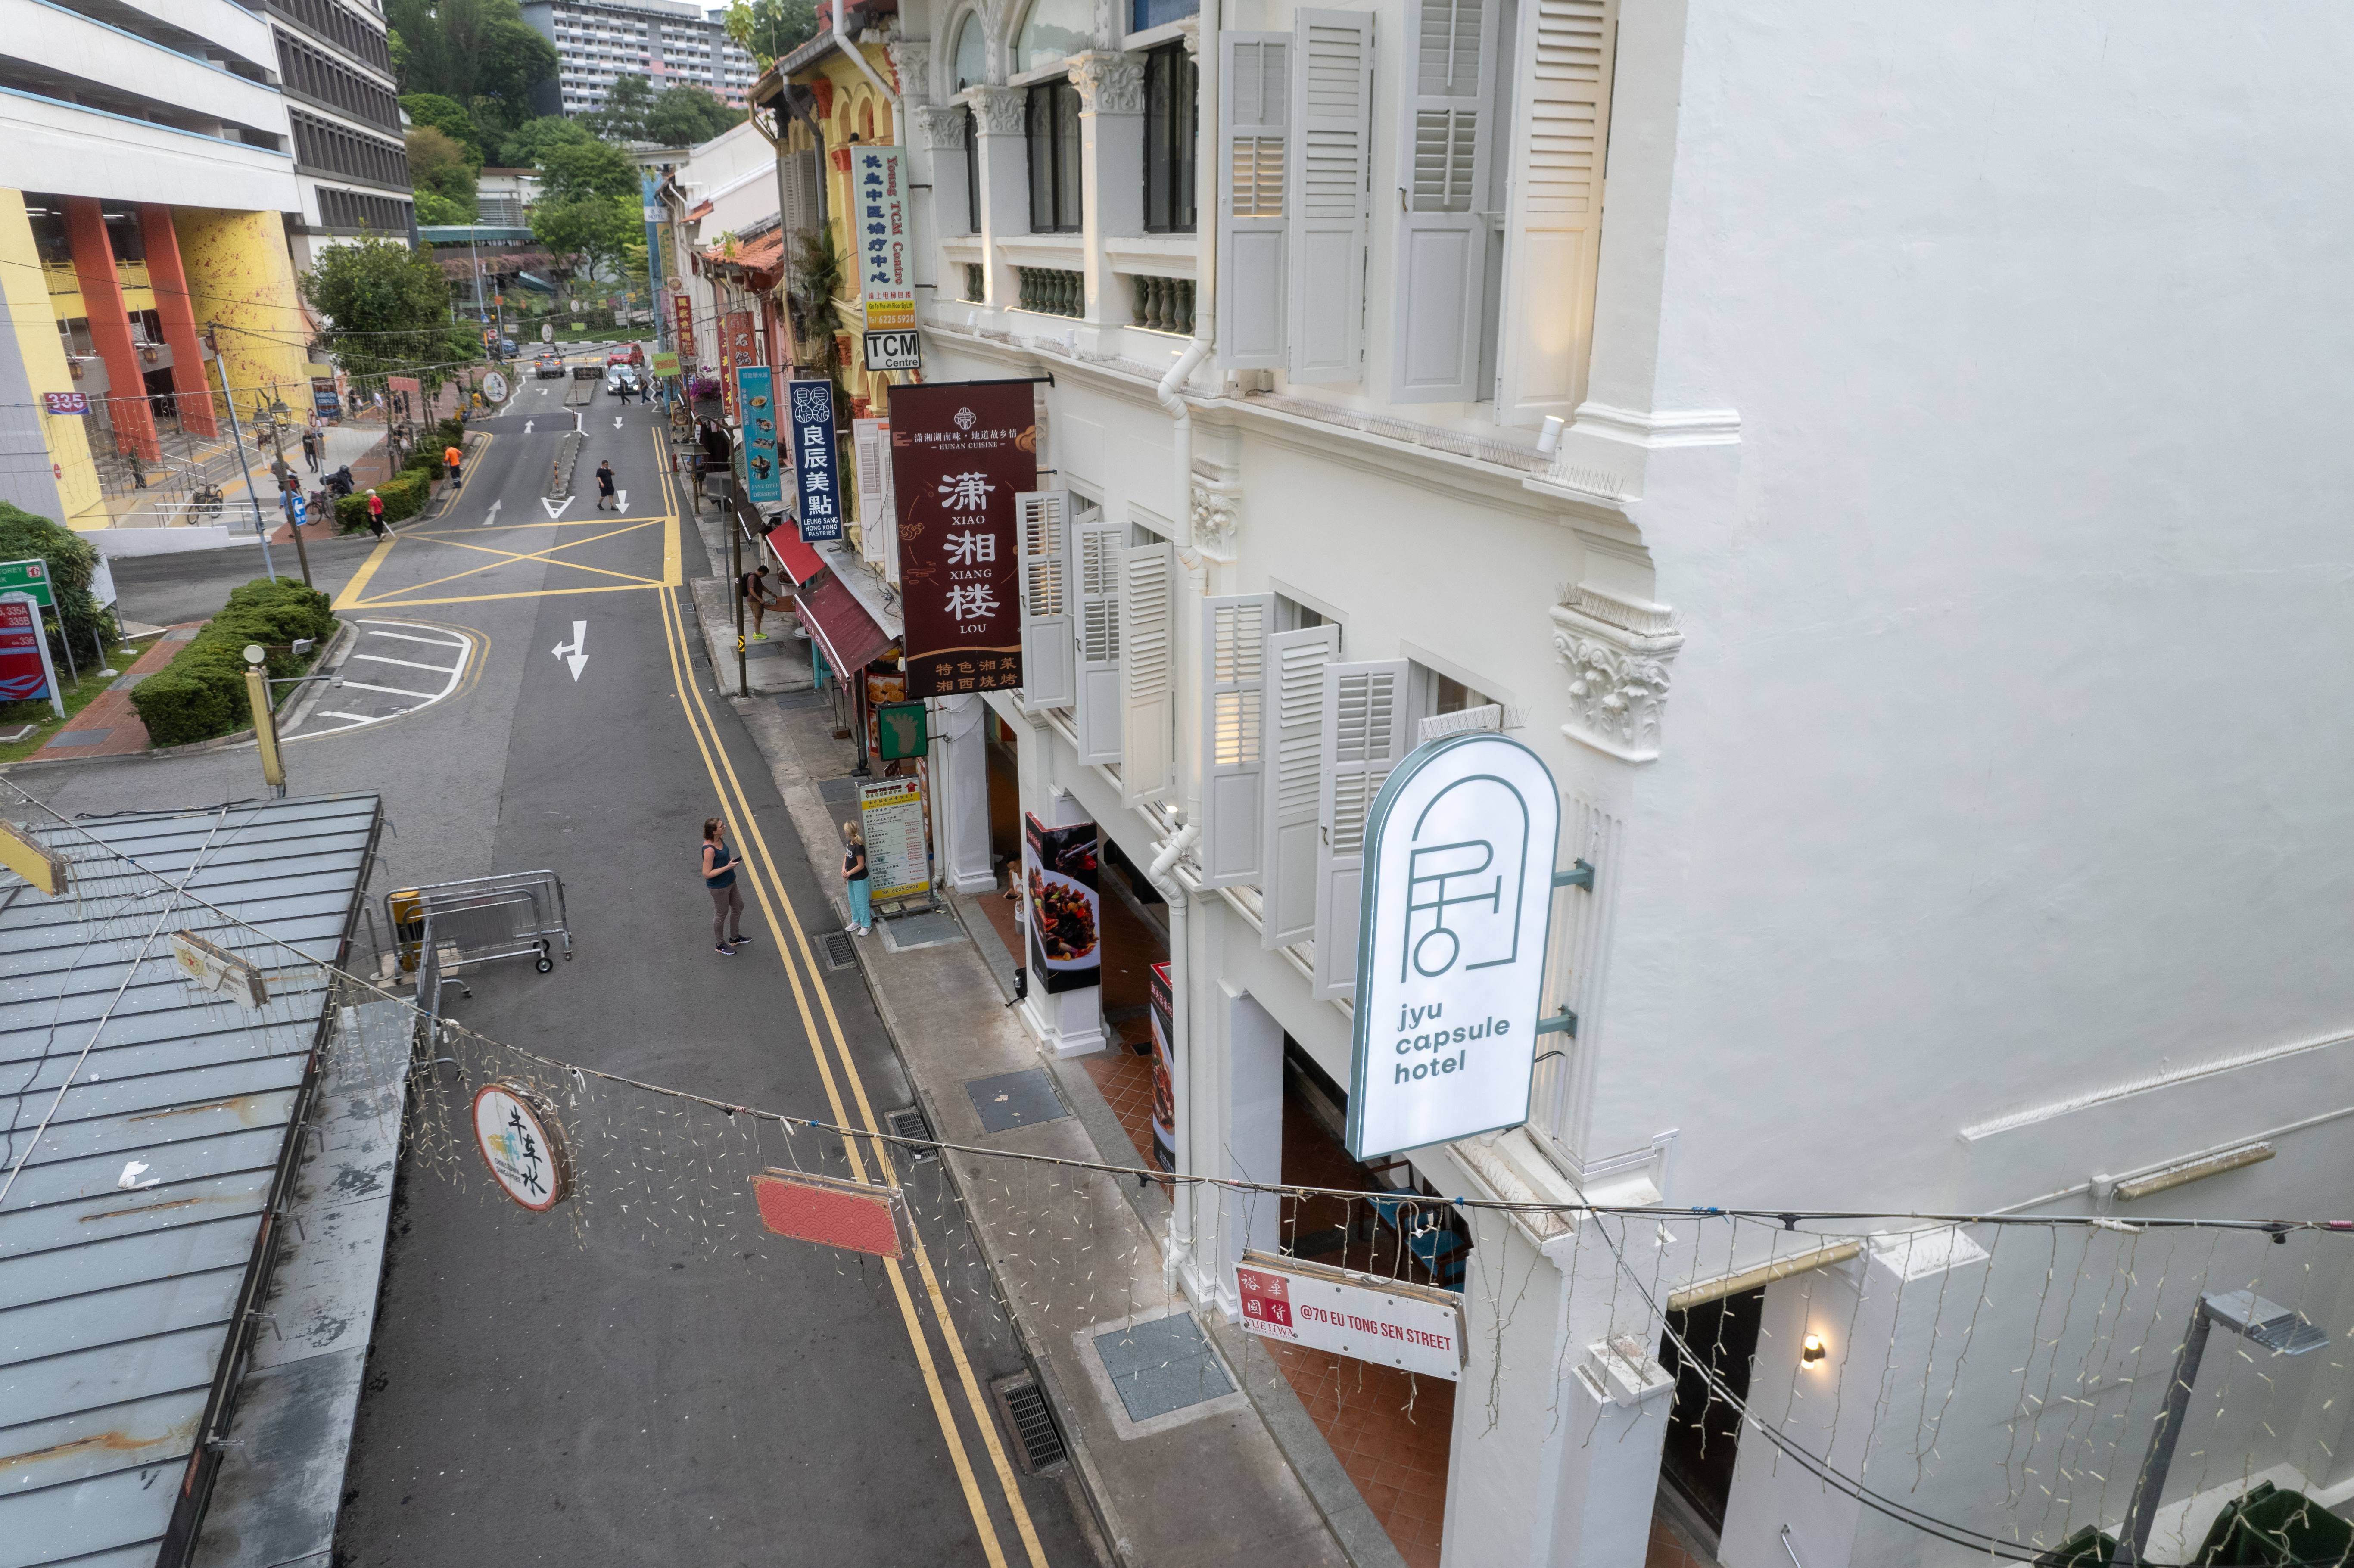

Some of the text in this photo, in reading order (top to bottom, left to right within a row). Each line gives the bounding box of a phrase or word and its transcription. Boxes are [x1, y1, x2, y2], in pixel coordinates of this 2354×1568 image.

[887, 156, 903, 285] Young TCM Centre
[869, 291, 911, 299] 请上电梯四楼
[878, 315, 896, 324] 6225
[897, 315, 914, 323] 5928
[868, 334, 917, 357] TCM
[885, 358, 918, 367] Centre
[48, 393, 84, 408] 335
[803, 425, 832, 516] 良辰美點
[952, 515, 985, 525] XIAO
[950, 569, 992, 580] XIANG
[6, 606, 28, 616] 335A
[9, 616, 31, 626] 335B
[960, 624, 987, 634] LOU
[20, 636, 35, 645] 336
[936, 657, 1017, 676] 特色湘菜
[936, 673, 1018, 692] 湘西烧烤
[1398, 1003, 1443, 1032] jyu
[1395, 1016, 1511, 1055] capsule
[1395, 1050, 1466, 1084] hotel
[1244, 1318, 1295, 1338] YUE HWA
[1300, 1305, 1451, 1351] @70 EU TONG SEN STREET
